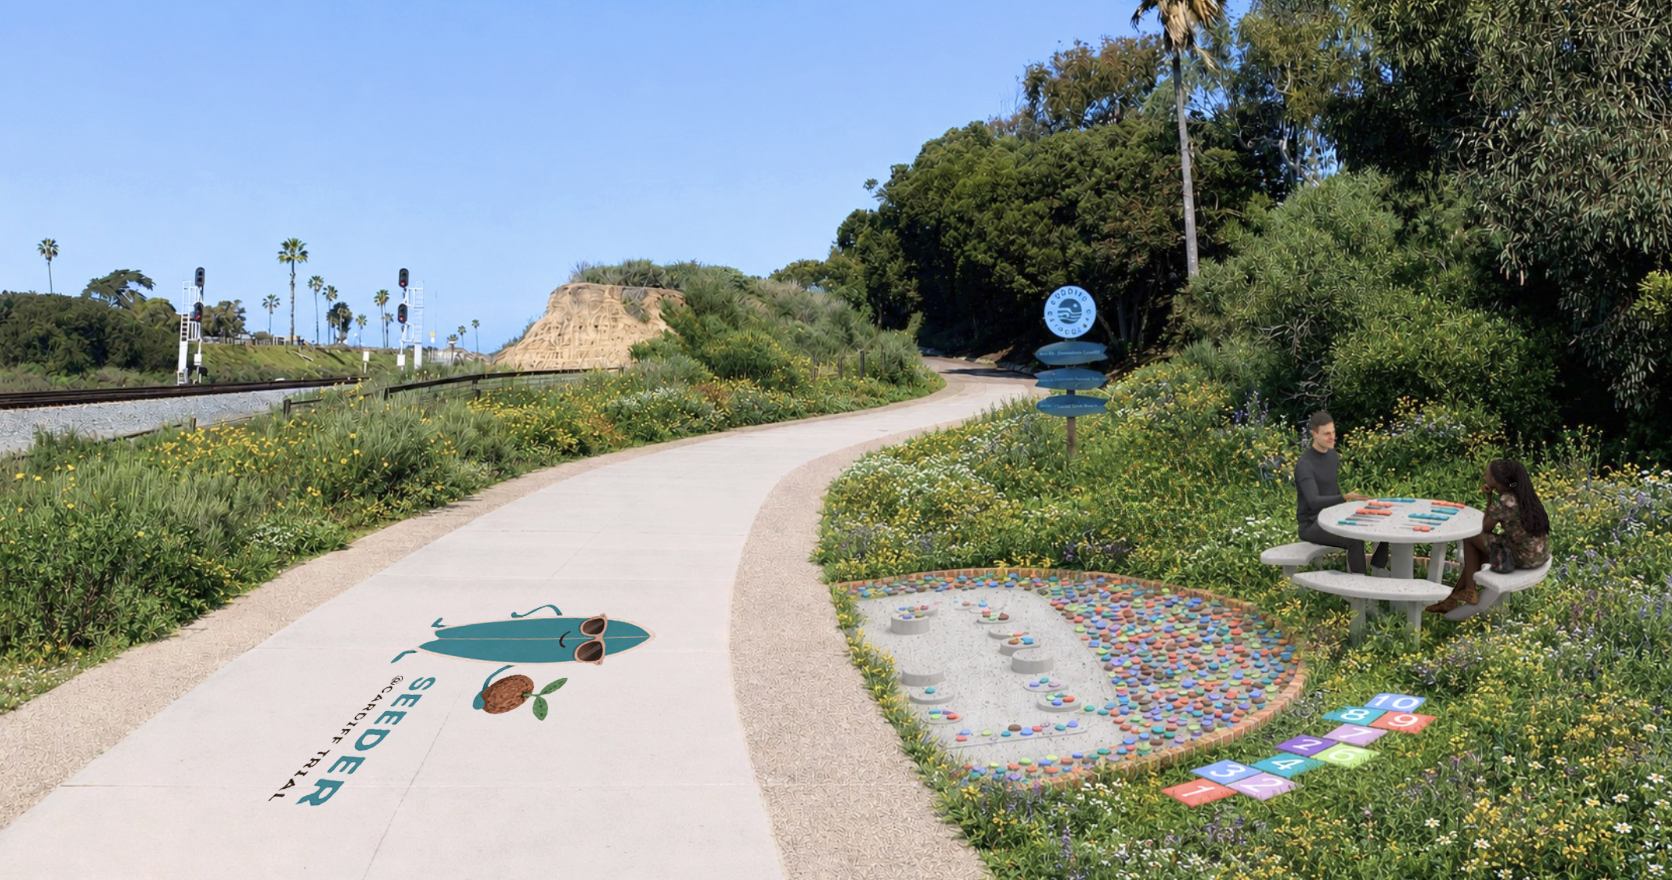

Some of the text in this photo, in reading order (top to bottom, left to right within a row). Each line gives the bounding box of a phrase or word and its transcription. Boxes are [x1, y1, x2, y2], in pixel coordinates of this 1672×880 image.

[1374, 696, 1419, 709] 10
[1340, 708, 1370, 721] 8
[1387, 714, 1419, 727] 9
[268, 675, 404, 802] @CARDIFF TRIAL
[1338, 727, 1373, 739] 7
[295, 677, 436, 806] SEEDER
[1328, 748, 1363, 761] 6
[1210, 765, 1246, 778] 3
[1271, 759, 1305, 771] 4
[1182, 785, 1215, 797] 1
[1240, 778, 1283, 792] 2
